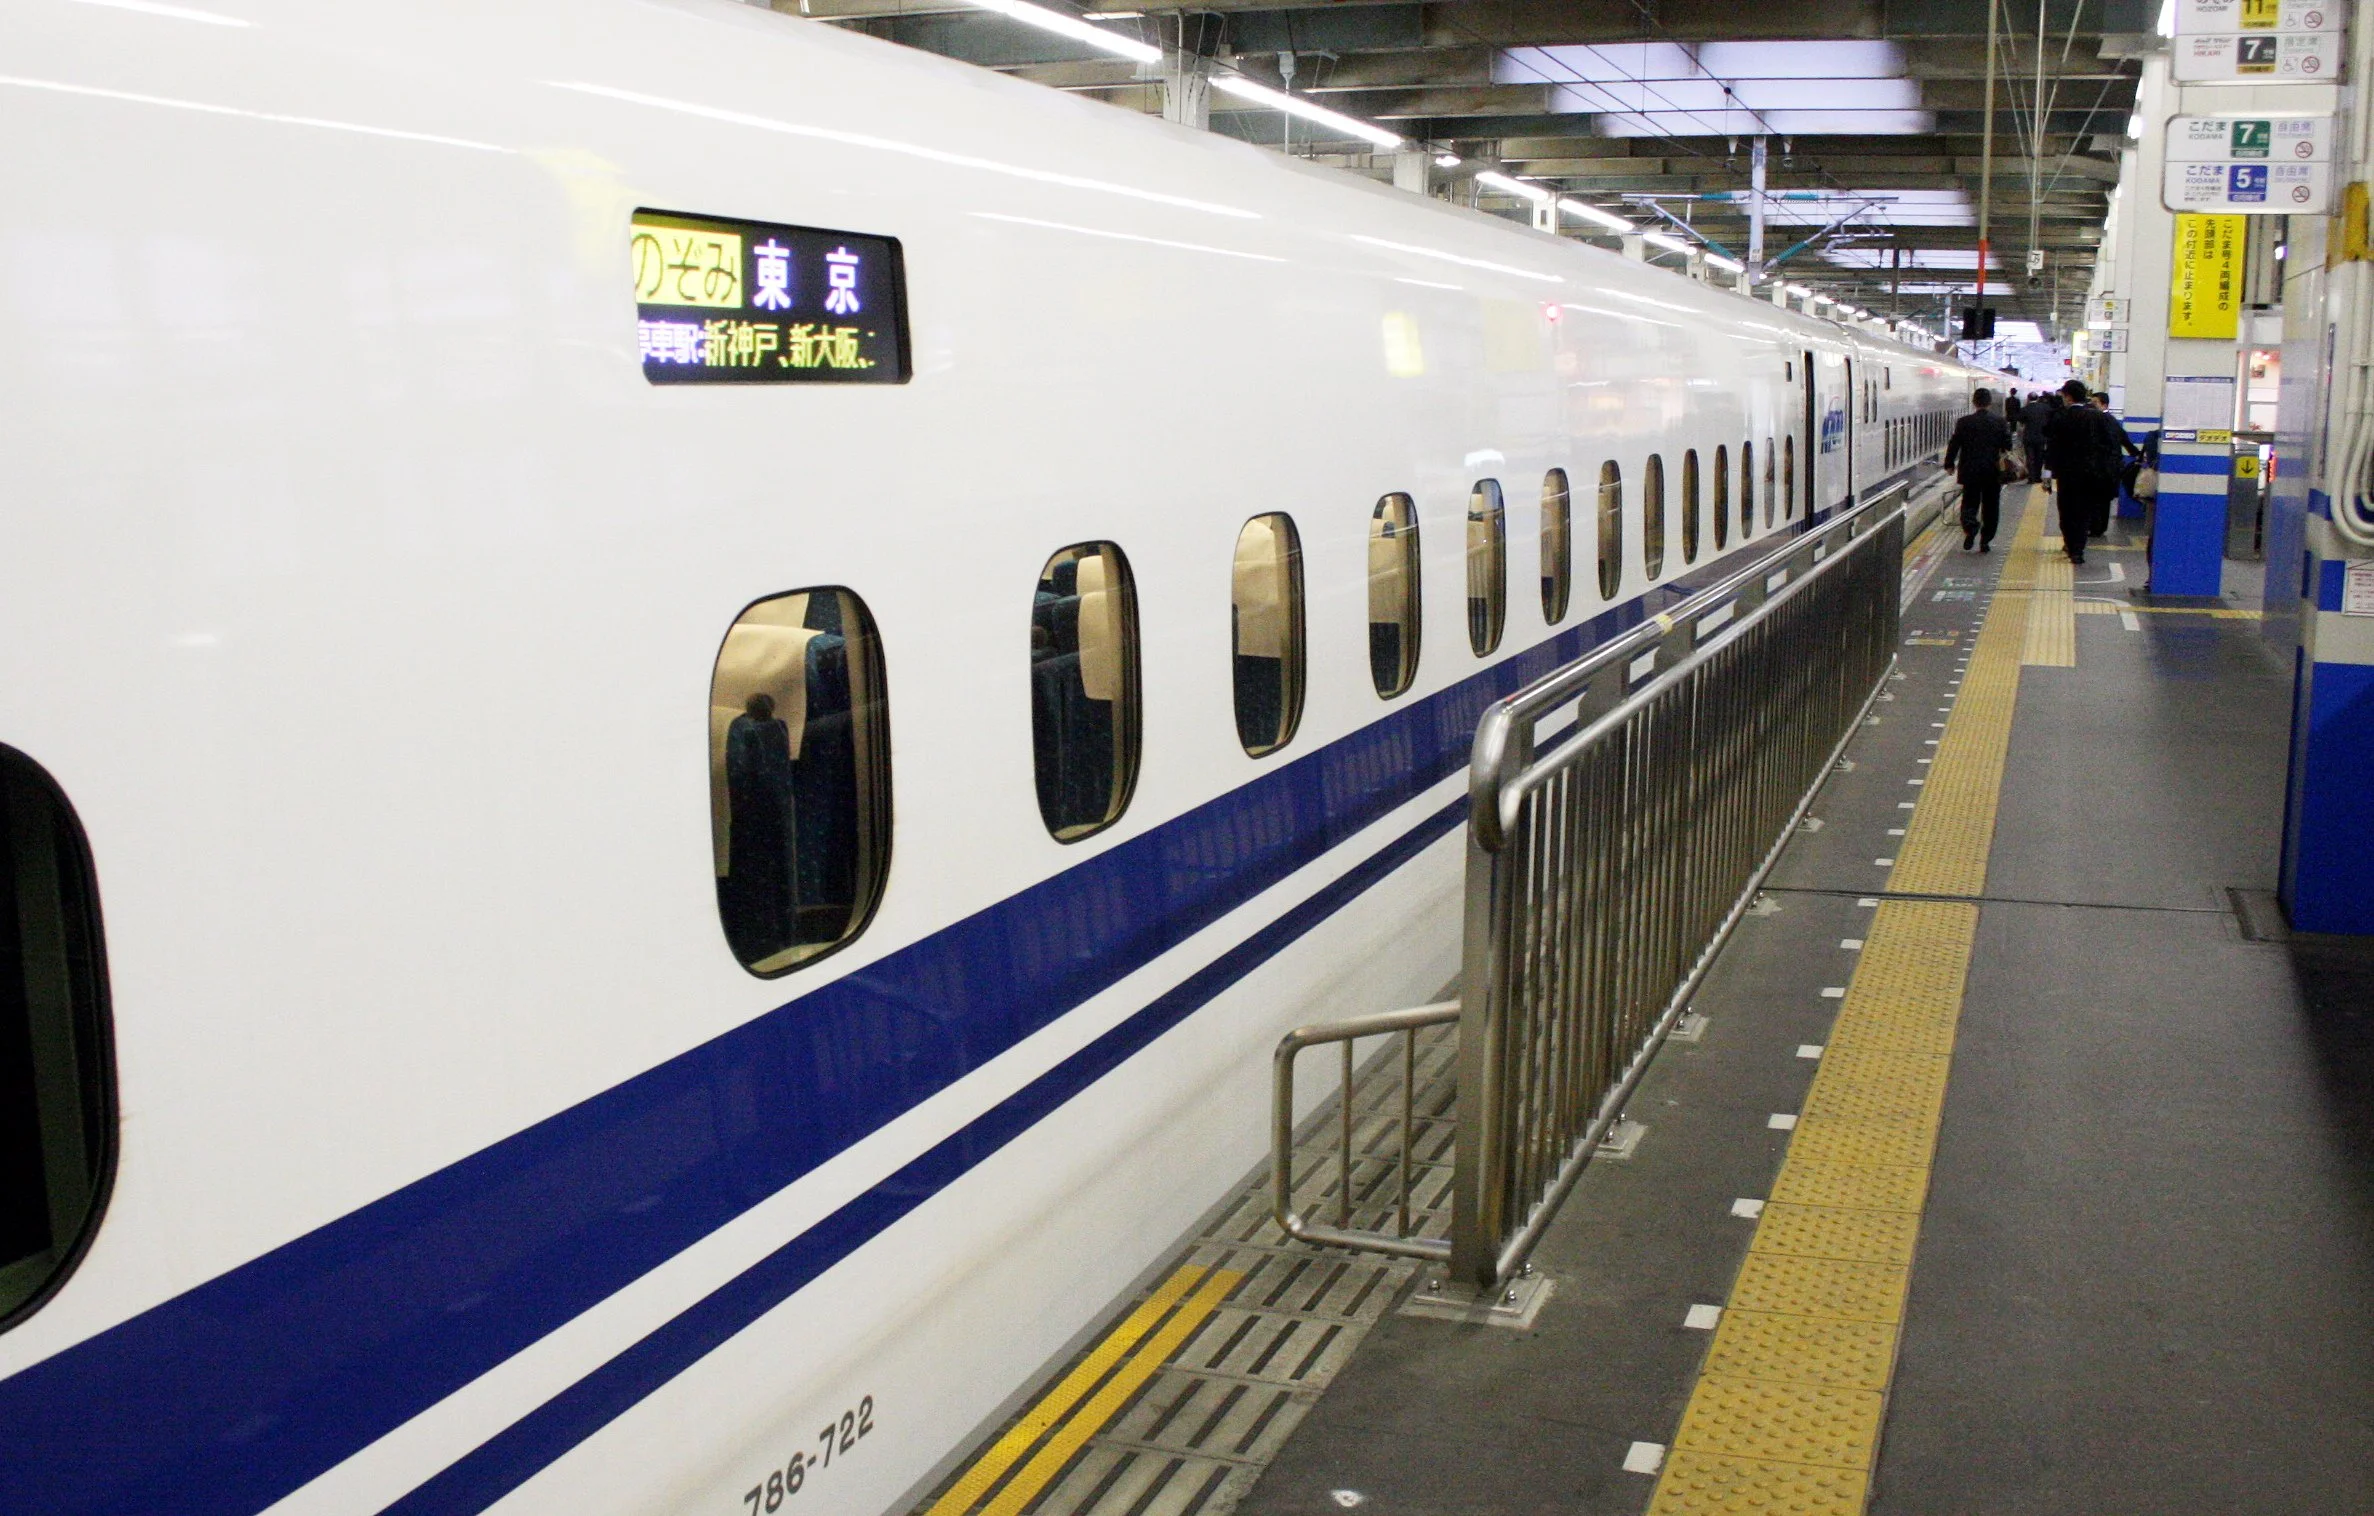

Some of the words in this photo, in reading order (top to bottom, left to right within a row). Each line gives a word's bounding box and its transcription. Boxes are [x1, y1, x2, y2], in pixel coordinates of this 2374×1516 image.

[2245, 39, 2261, 60] 7
[2189, 121, 2227, 132] こだま
[2240, 123, 2256, 144] 7
[2186, 165, 2224, 176] こだま
[2236, 168, 2252, 189] 5
[631, 232, 737, 302] のぞみ
[744, 1394, 875, 1516] 786-722
